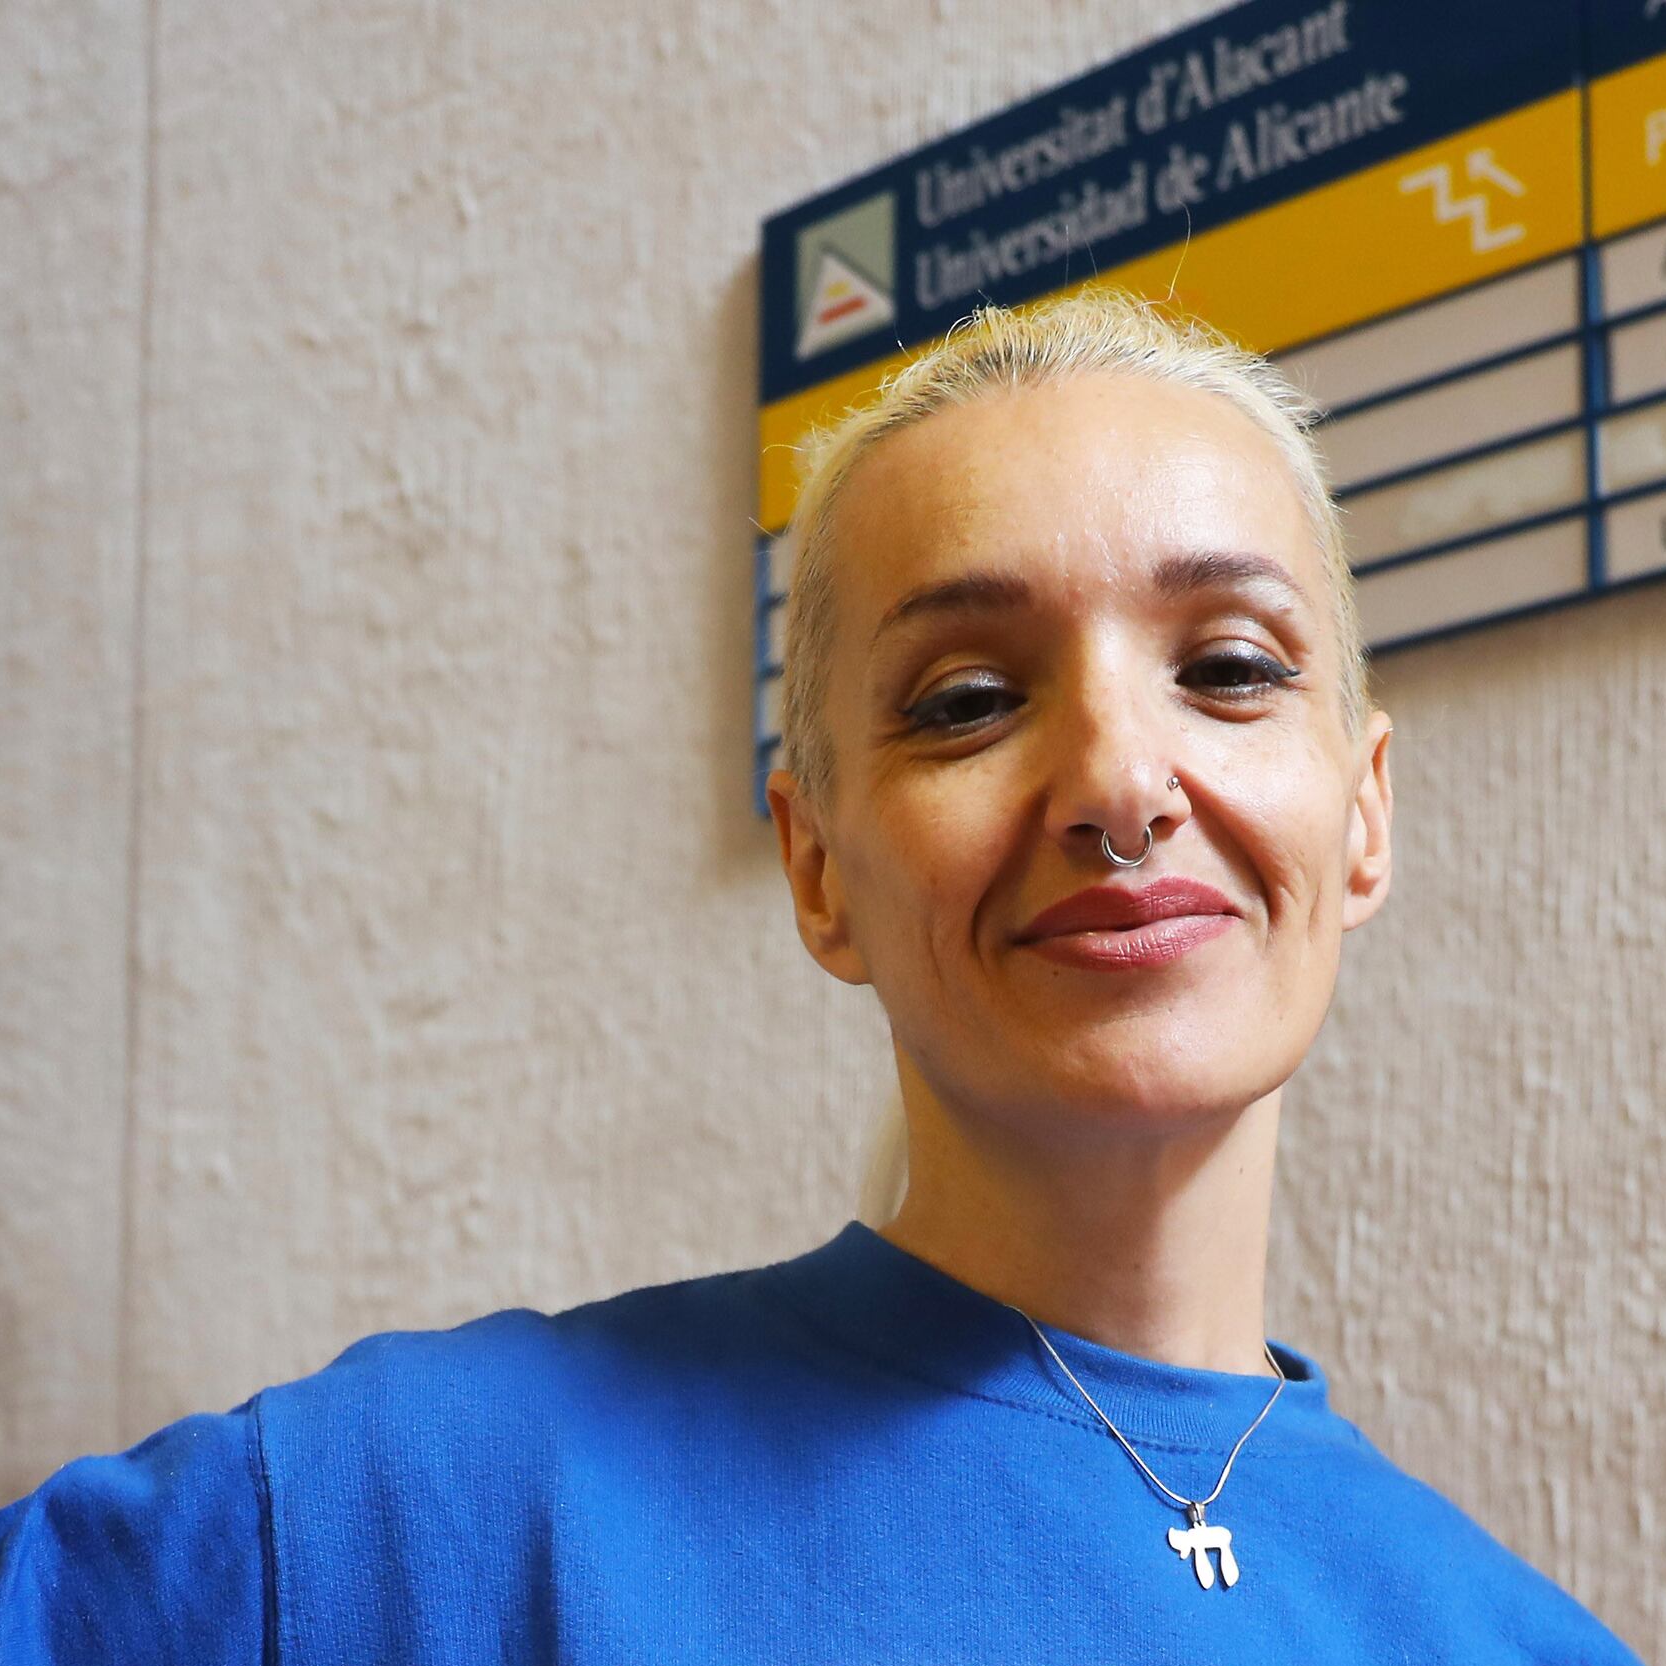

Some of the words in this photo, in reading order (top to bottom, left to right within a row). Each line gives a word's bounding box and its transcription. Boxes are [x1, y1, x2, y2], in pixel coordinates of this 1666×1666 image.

[915, 92, 1129, 230] Universitat
[1135, 2, 1350, 135] d'Alacant
[915, 160, 1147, 309] Universidad
[1155, 144, 1210, 212] de
[1217, 72, 1410, 192] Alicante
